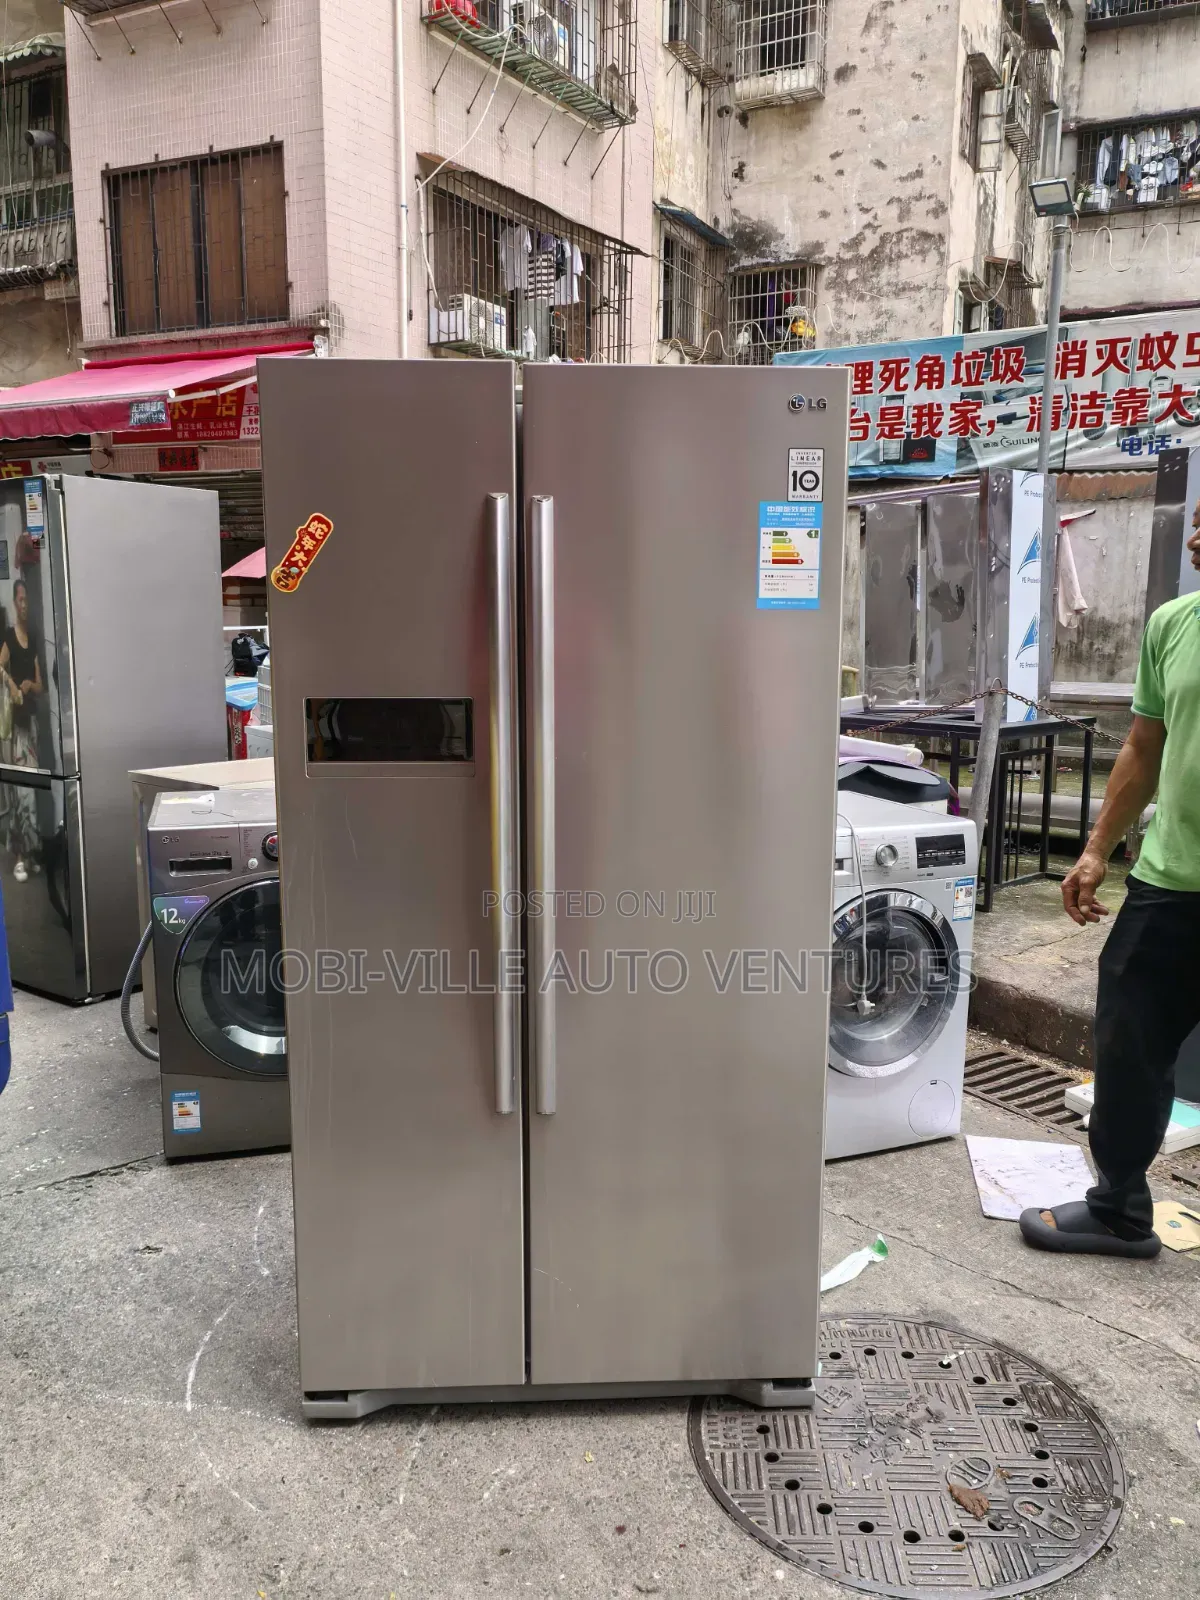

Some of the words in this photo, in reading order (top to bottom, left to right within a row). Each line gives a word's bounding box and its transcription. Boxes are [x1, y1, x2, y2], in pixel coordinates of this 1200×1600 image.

[826, 347, 1026, 395] 理死角垃圾
[792, 470, 820, 492] 10
[275, 520, 329, 589] 蛇年大吉
